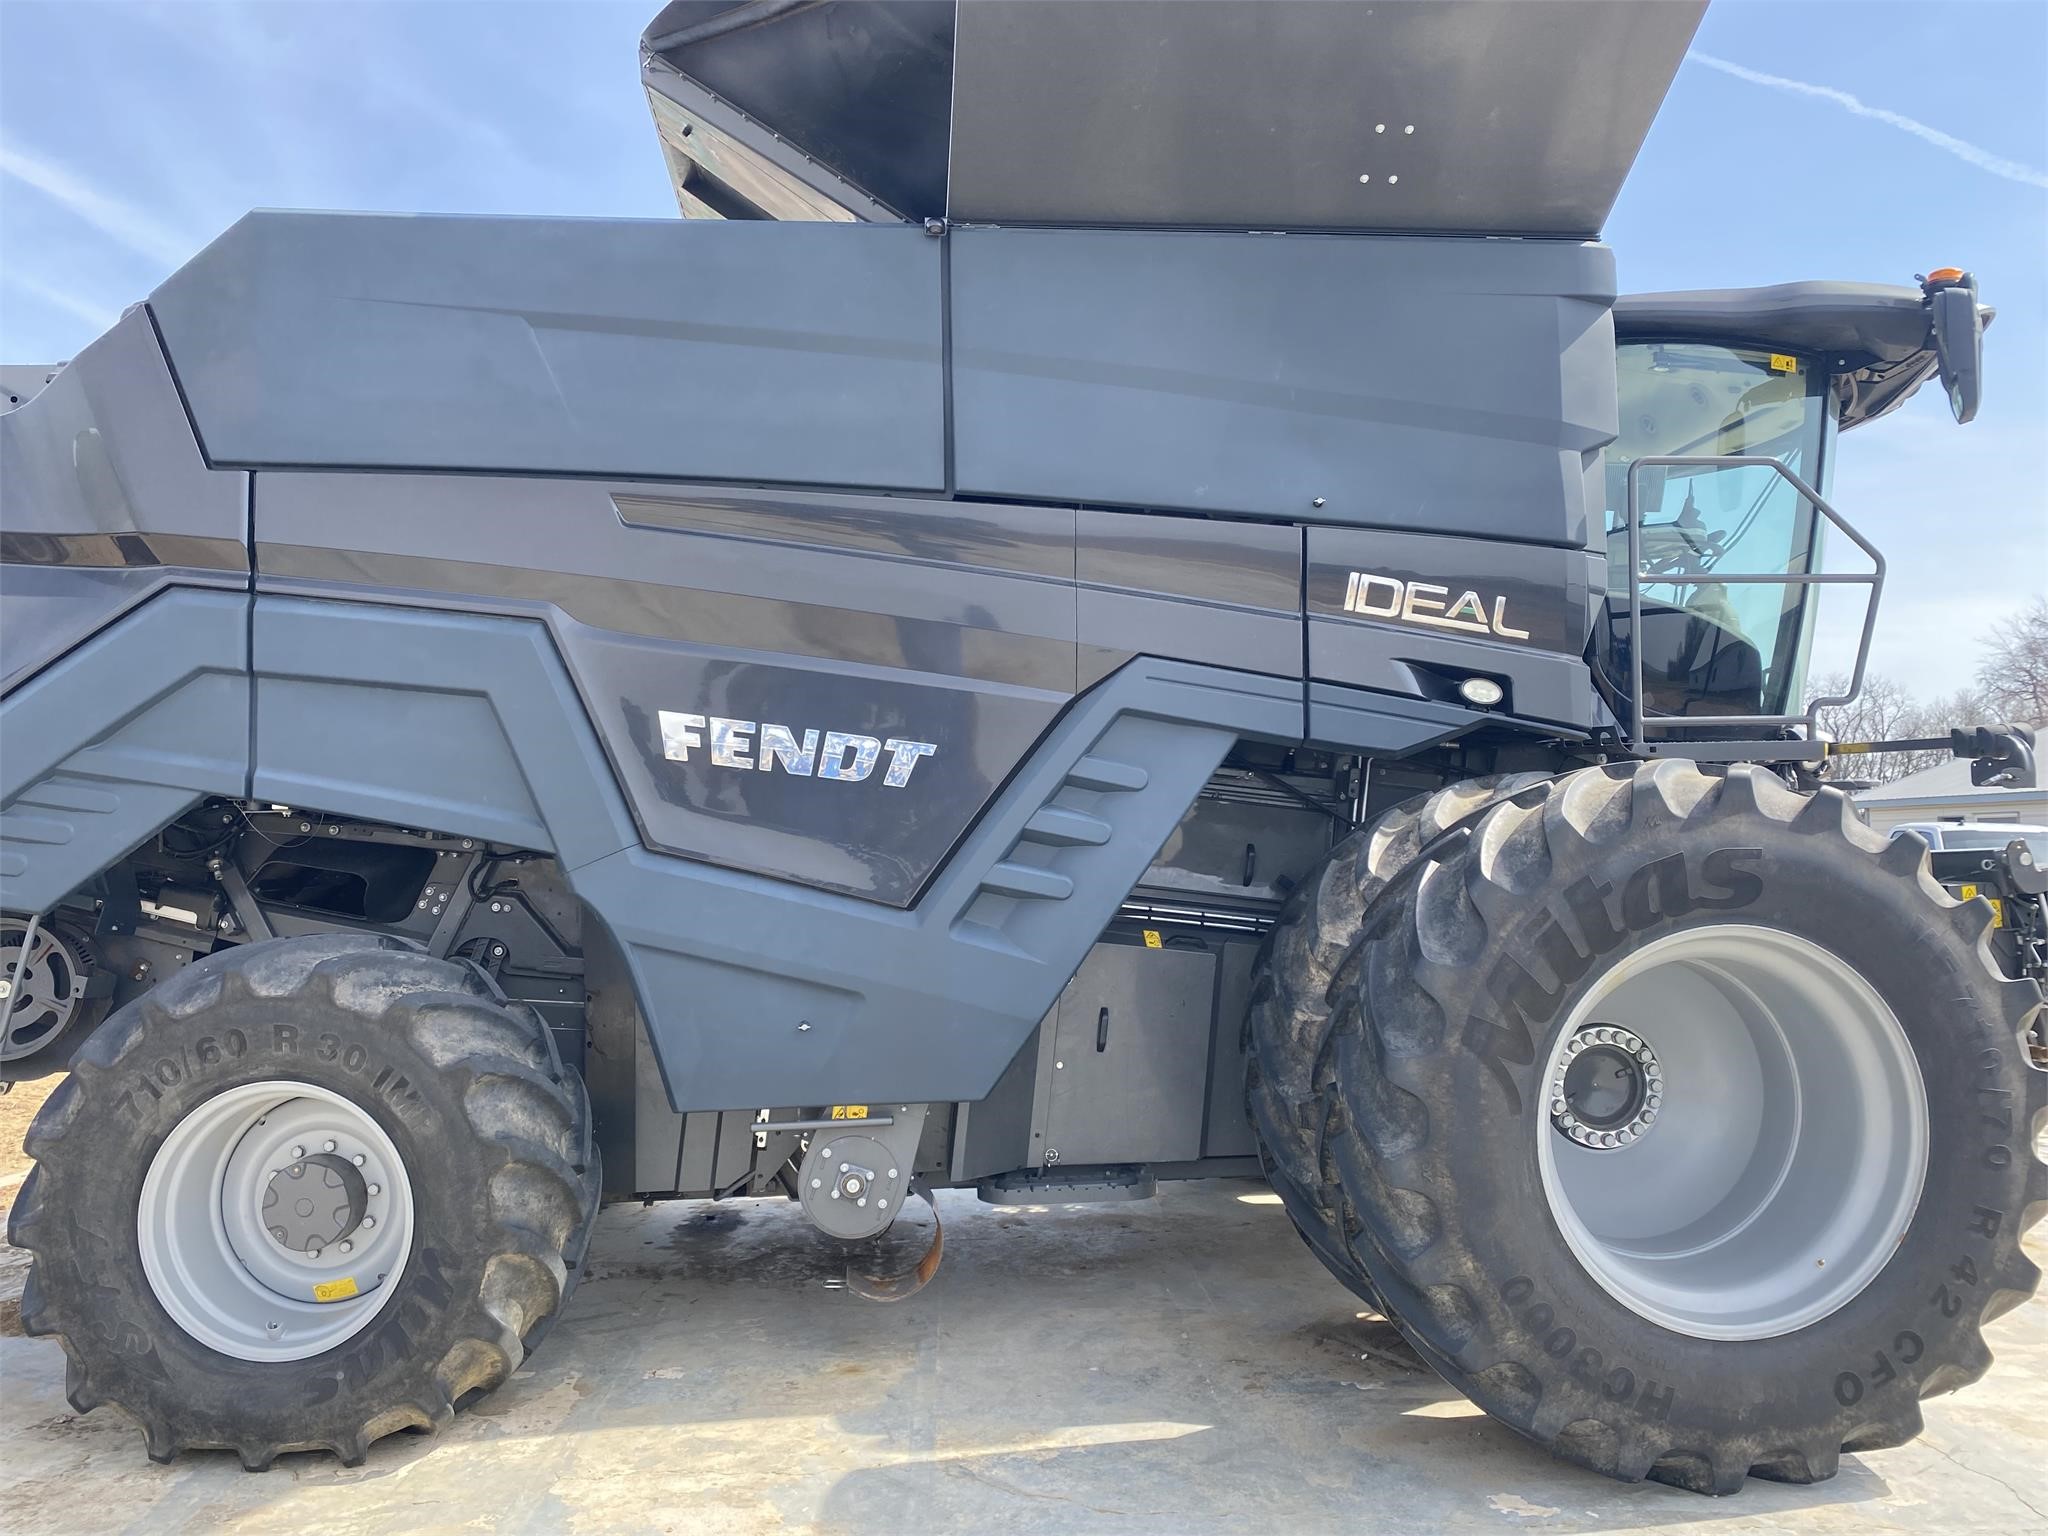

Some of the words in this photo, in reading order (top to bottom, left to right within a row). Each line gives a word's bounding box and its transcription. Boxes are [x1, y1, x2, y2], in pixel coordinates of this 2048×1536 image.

[1344, 571, 1530, 640] IDEAL
[658, 710, 938, 788] FENDT
[1461, 847, 1764, 1116] Mitas
[111, 1027, 250, 1117] 710/60
[272, 1022, 301, 1057] R
[316, 1032, 369, 1074] 30
[1967, 1204, 2005, 1239] R
[1929, 1254, 1979, 1319] 42
[1833, 1329, 1925, 1407] CFO
